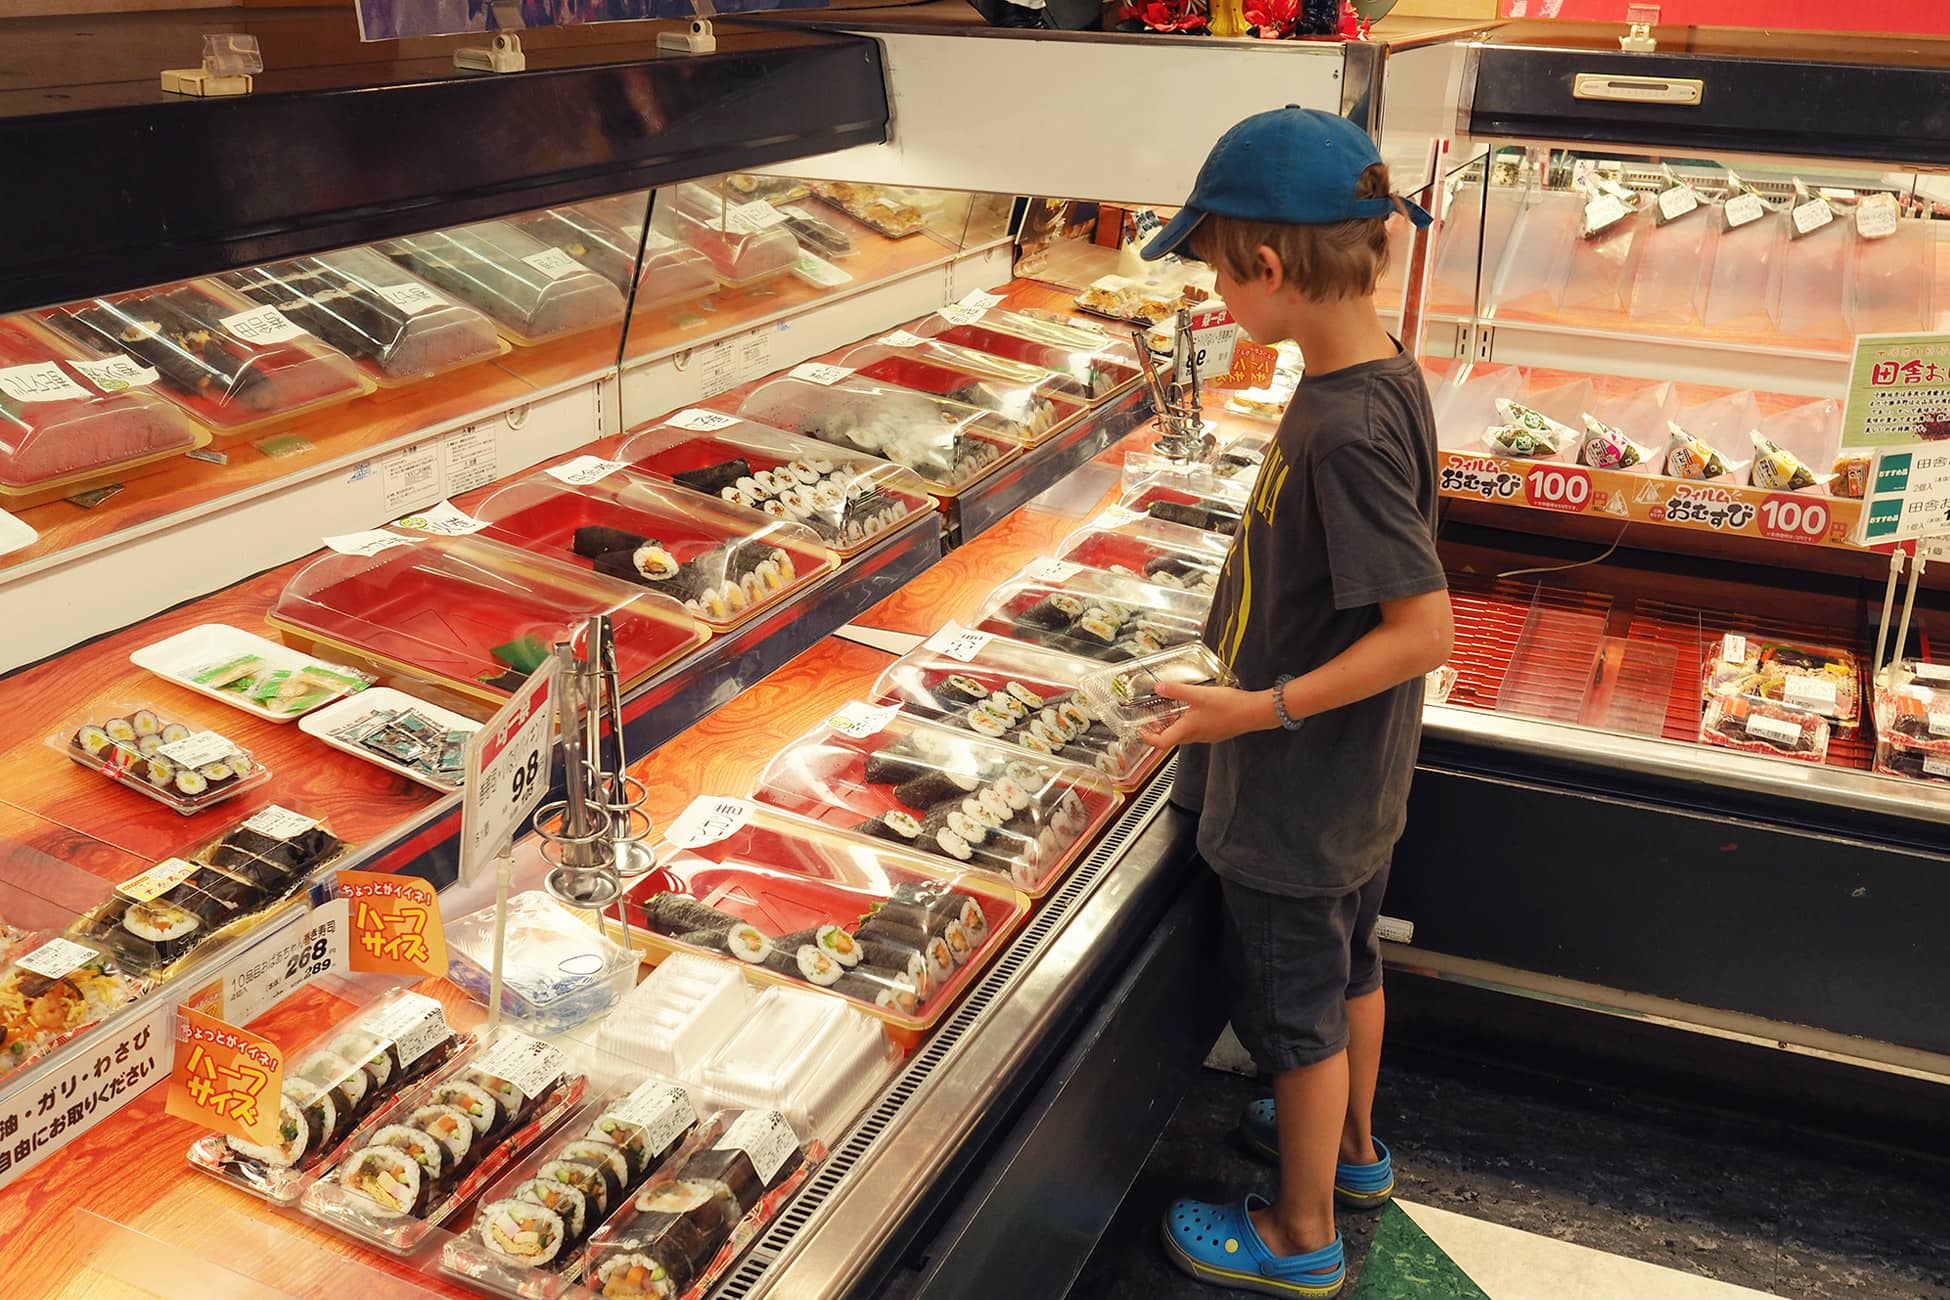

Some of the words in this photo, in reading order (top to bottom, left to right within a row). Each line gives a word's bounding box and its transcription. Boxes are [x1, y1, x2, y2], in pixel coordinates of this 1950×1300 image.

[1871, 359, 1950, 386] 田舎お
[1450, 457, 1499, 474] フィルム
[1916, 456, 1950, 470] 田舎
[1440, 467, 1522, 498] おむすび
[1528, 470, 1589, 504] 100
[1591, 491, 1608, 506] 円
[1677, 486, 1730, 505] フィルム
[1666, 498, 1755, 529] おむすび
[1760, 500, 1827, 535] 100
[511, 748, 539, 804] 98
[341, 882, 432, 906] ちょっとがイイネ!
[356, 902, 427, 935] ハーフ
[284, 937, 329, 981] 268
[361, 931, 430, 964] サイズ
[303, 957, 332, 983] 289
[187, 1045, 269, 1097] ハーフ
[188, 1078, 260, 1128] サイズ
